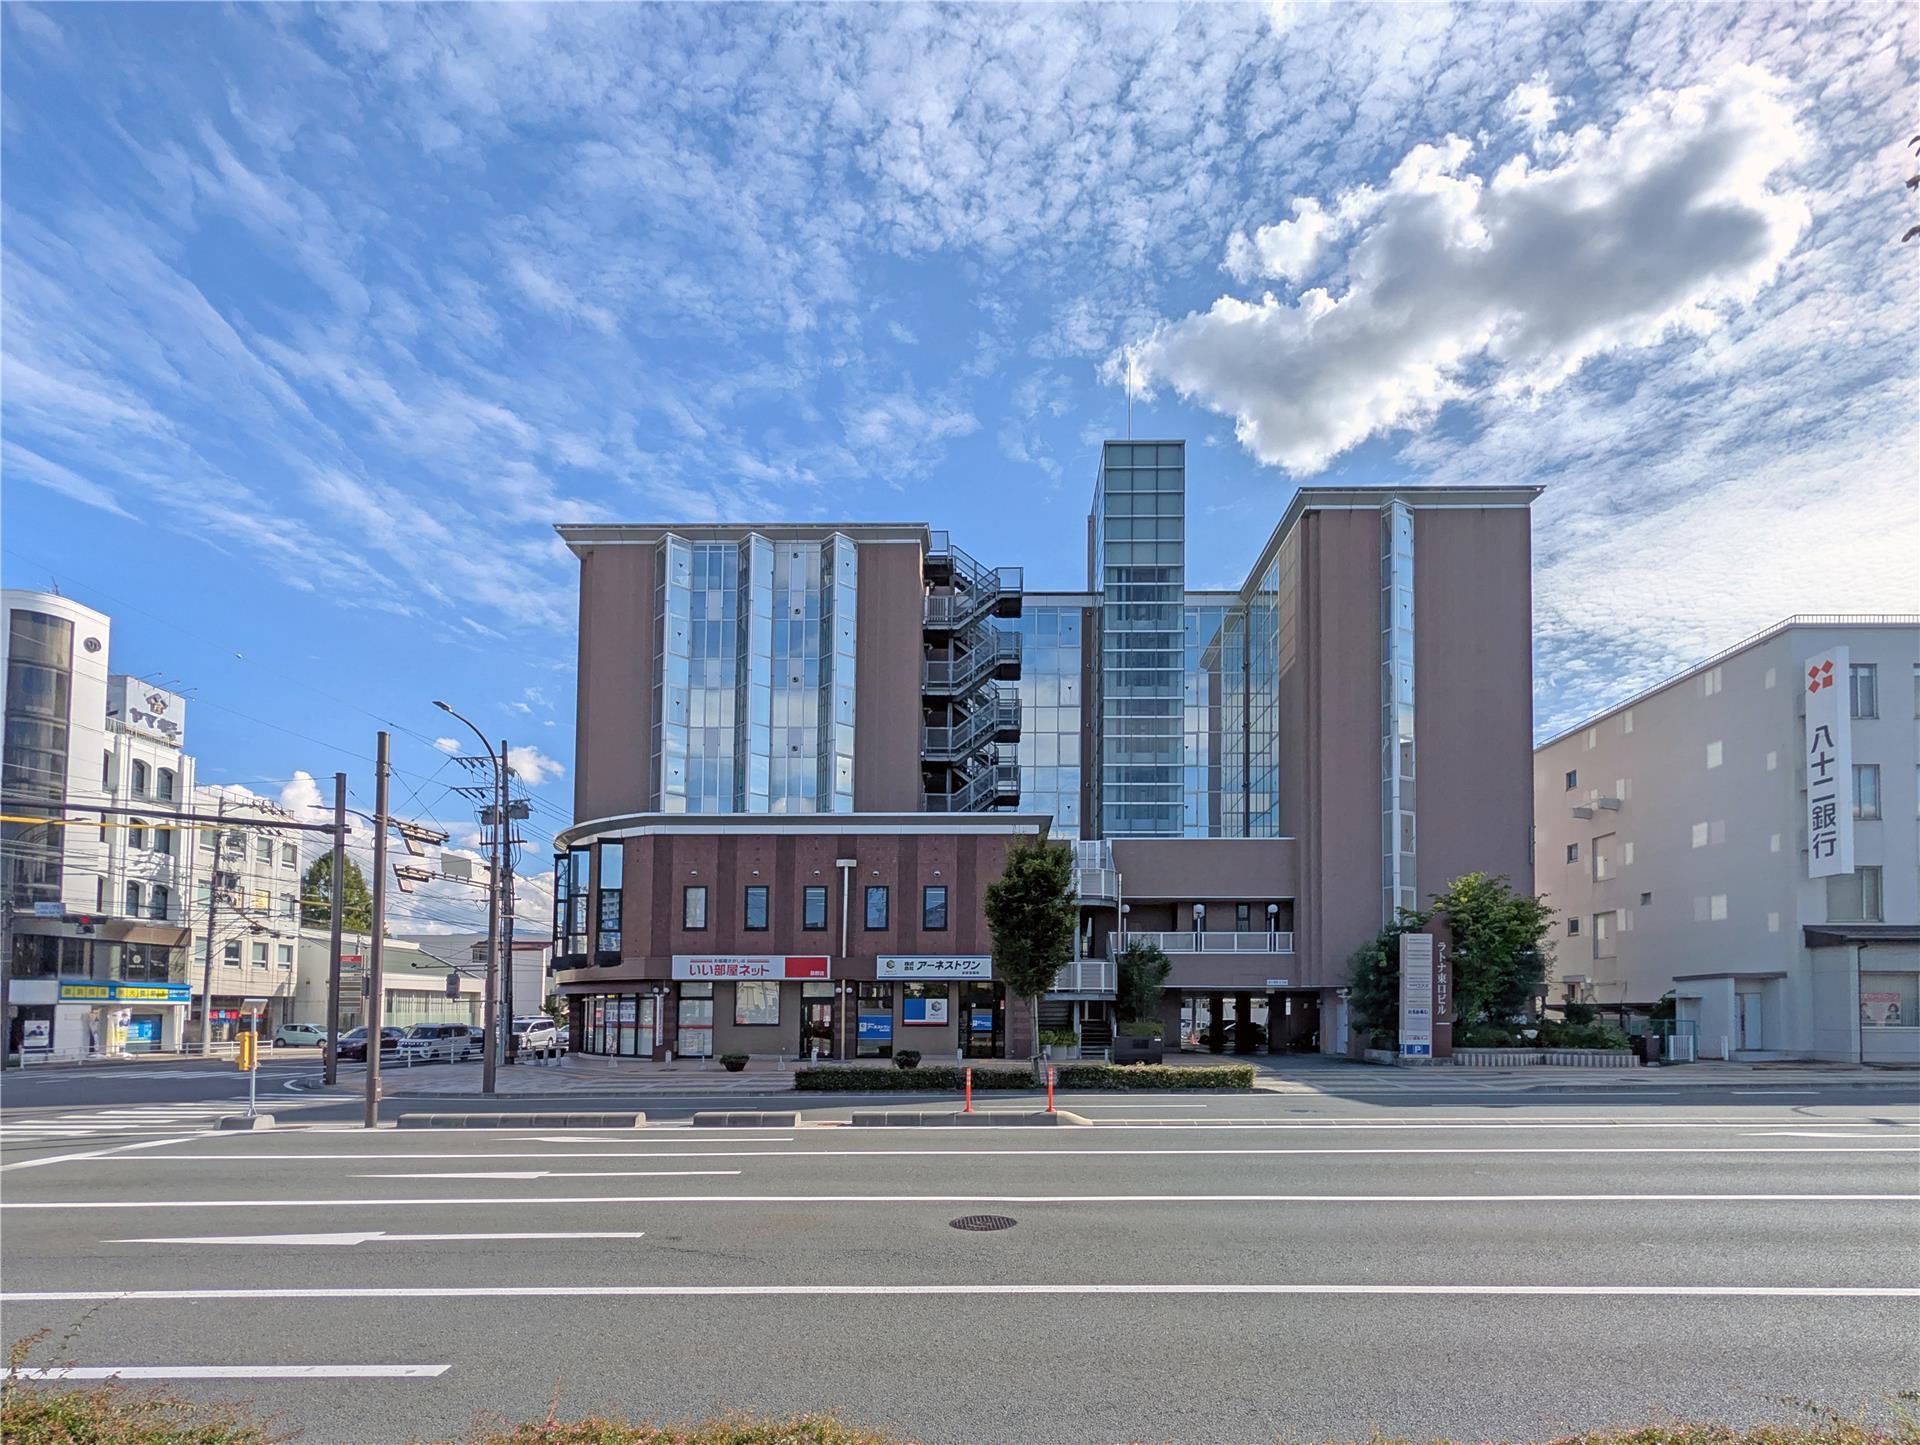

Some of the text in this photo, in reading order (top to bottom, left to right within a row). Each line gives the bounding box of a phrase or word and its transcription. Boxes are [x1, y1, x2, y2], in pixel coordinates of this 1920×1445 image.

[1810, 725, 1837, 859] 八十二銀行
[689, 964, 770, 977] いい部屋ネット
[917, 960, 981, 971] アーネストワン
[1437, 942, 1447, 1015] ラトナ東口ビル
